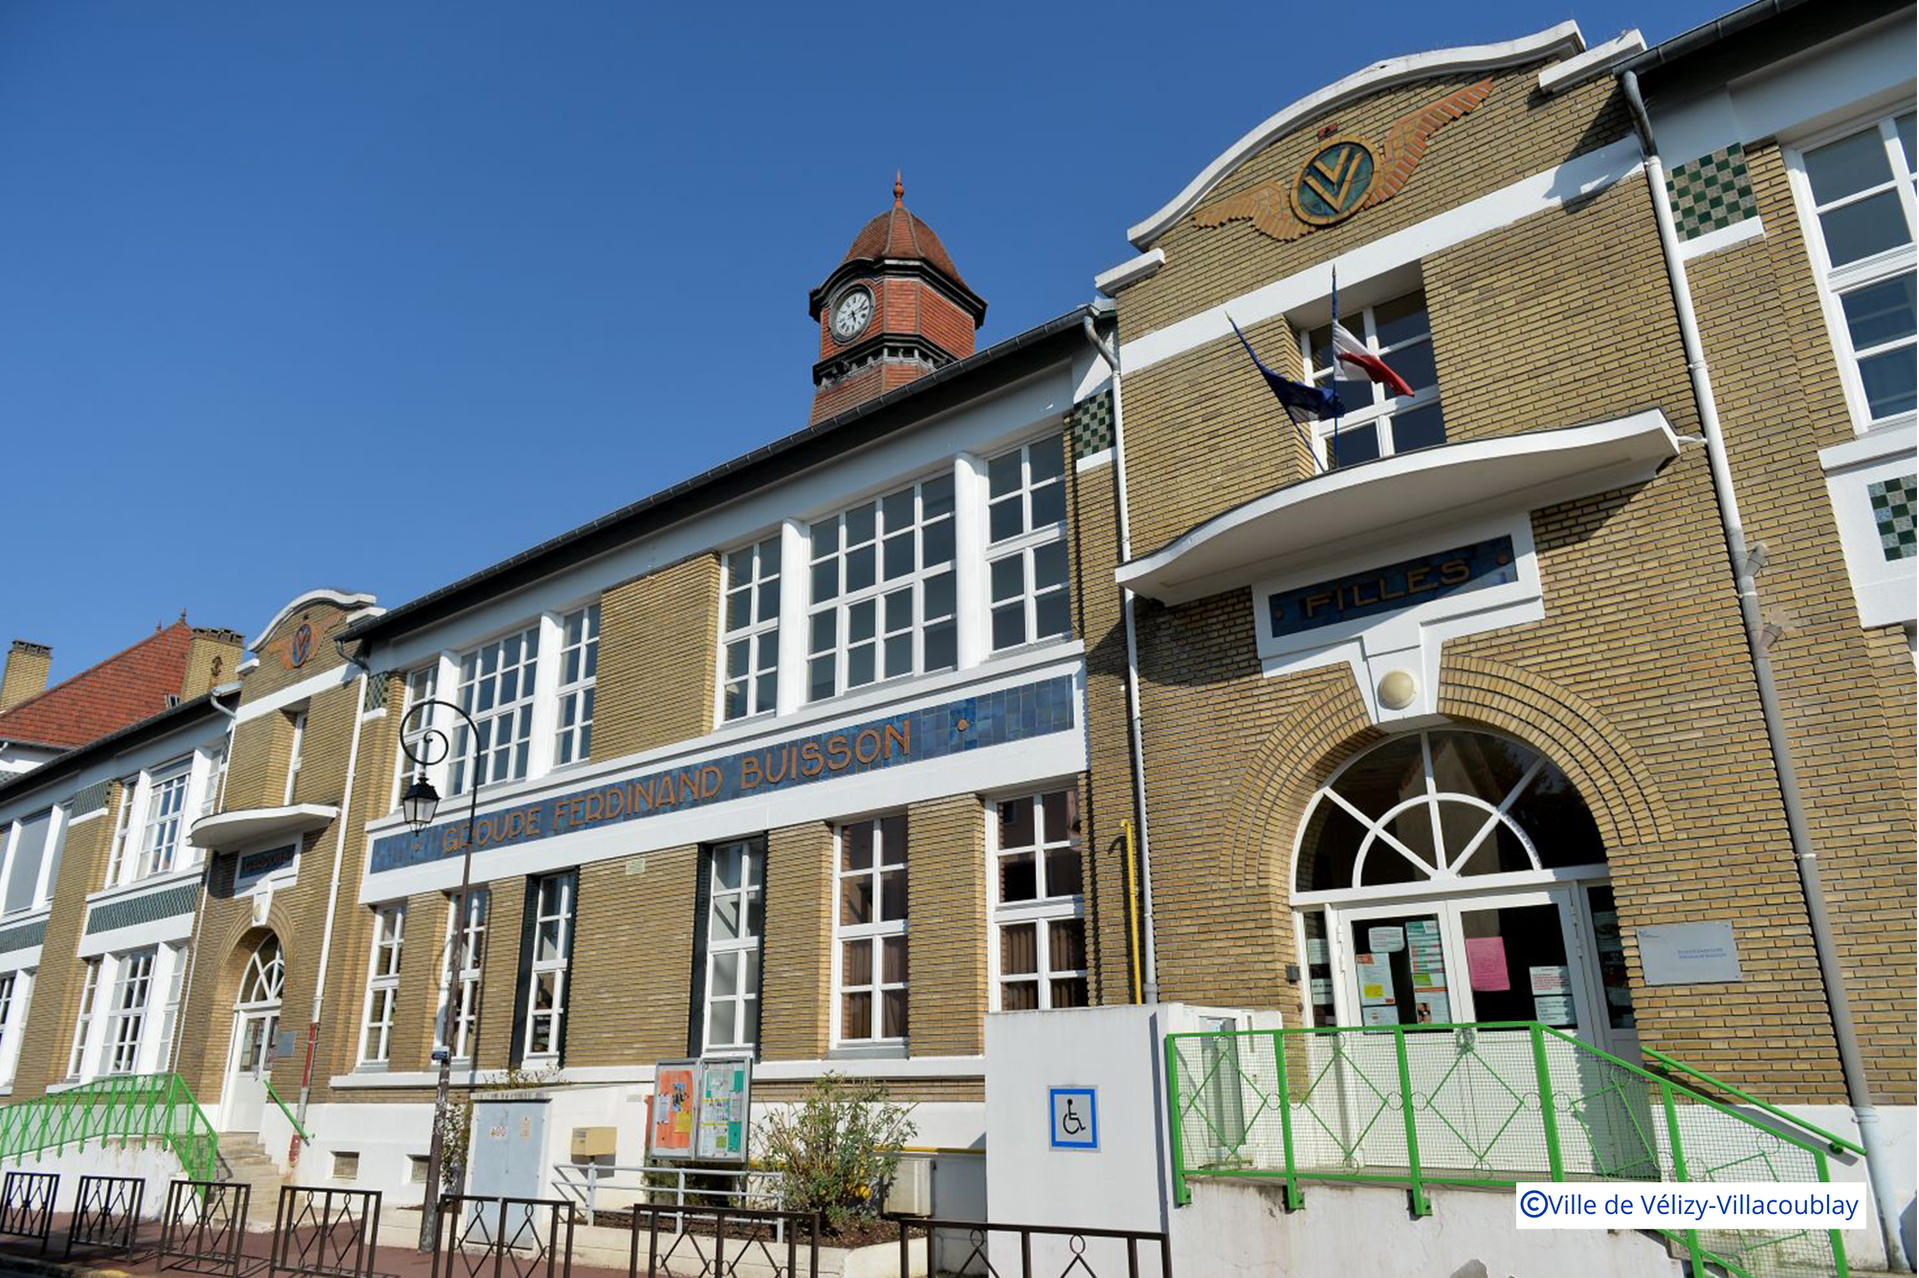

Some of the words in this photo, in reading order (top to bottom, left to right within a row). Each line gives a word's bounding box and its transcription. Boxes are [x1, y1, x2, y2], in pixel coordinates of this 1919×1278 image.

[1304, 557, 1471, 618] FILLES
[553, 765, 724, 830] FERDINAND
[740, 717, 912, 791] BUISSON
